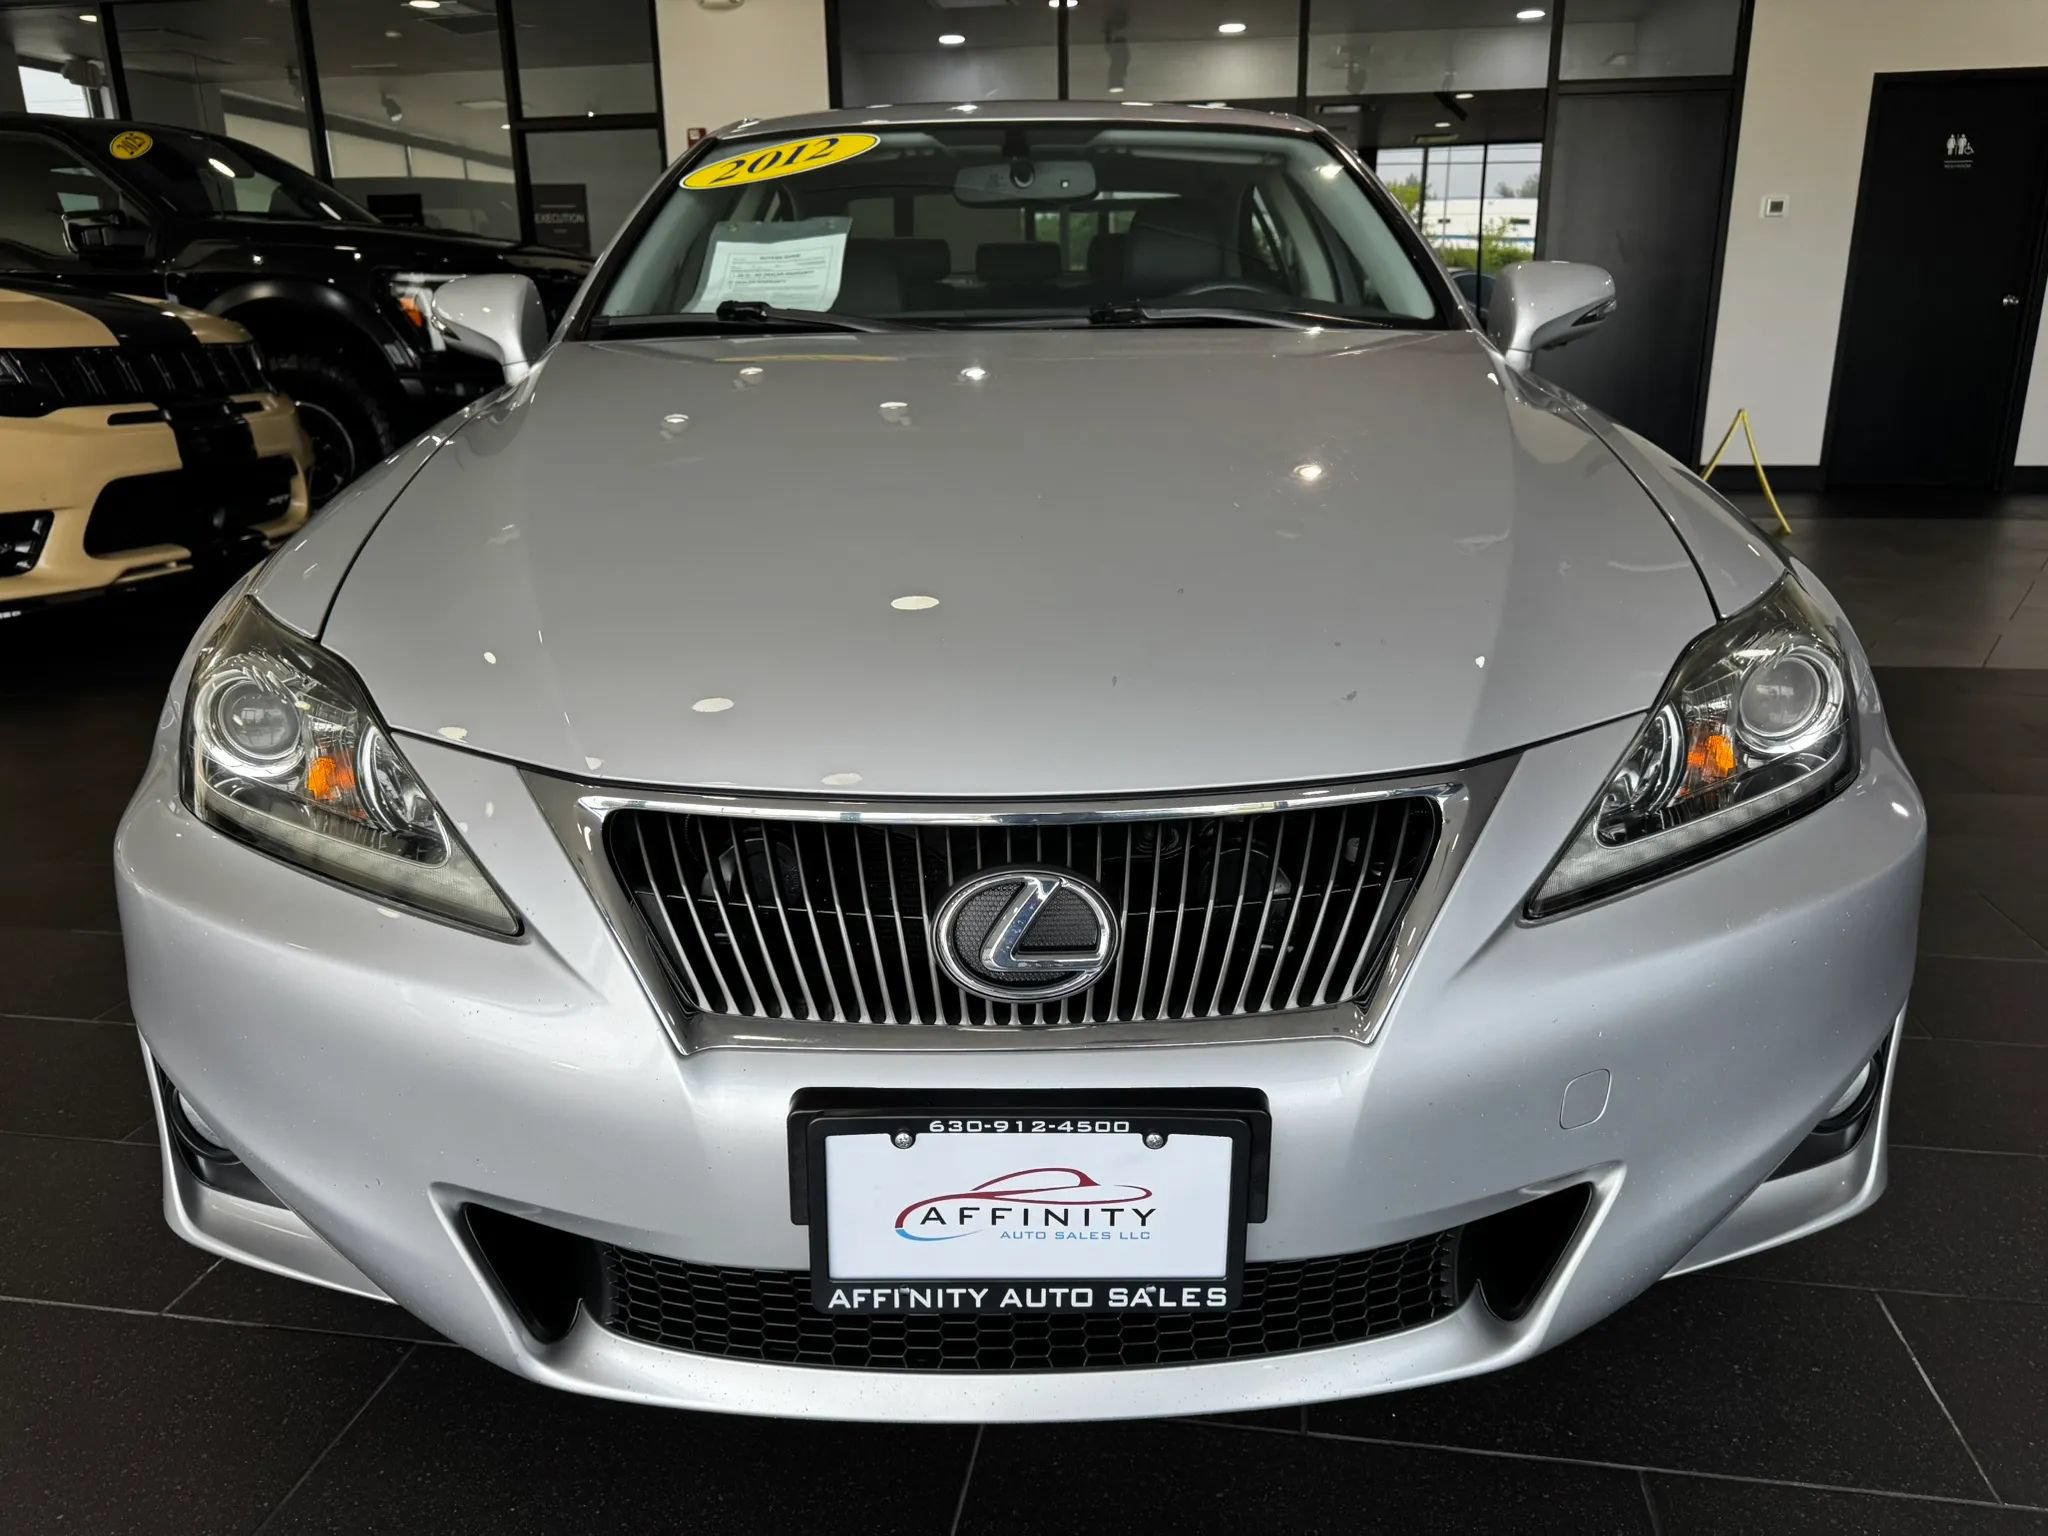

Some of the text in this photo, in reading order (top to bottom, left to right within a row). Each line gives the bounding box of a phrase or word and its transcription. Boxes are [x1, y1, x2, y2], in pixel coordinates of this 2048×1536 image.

[709, 138, 840, 184] 2012
[929, 1120, 1130, 1133] 630-912-4500
[920, 1206, 1157, 1227] AFFINITY
[1000, 1231, 1151, 1240] AUTO SALES LLC
[827, 1287, 1228, 1309] AFFINITY AUTO SALES
